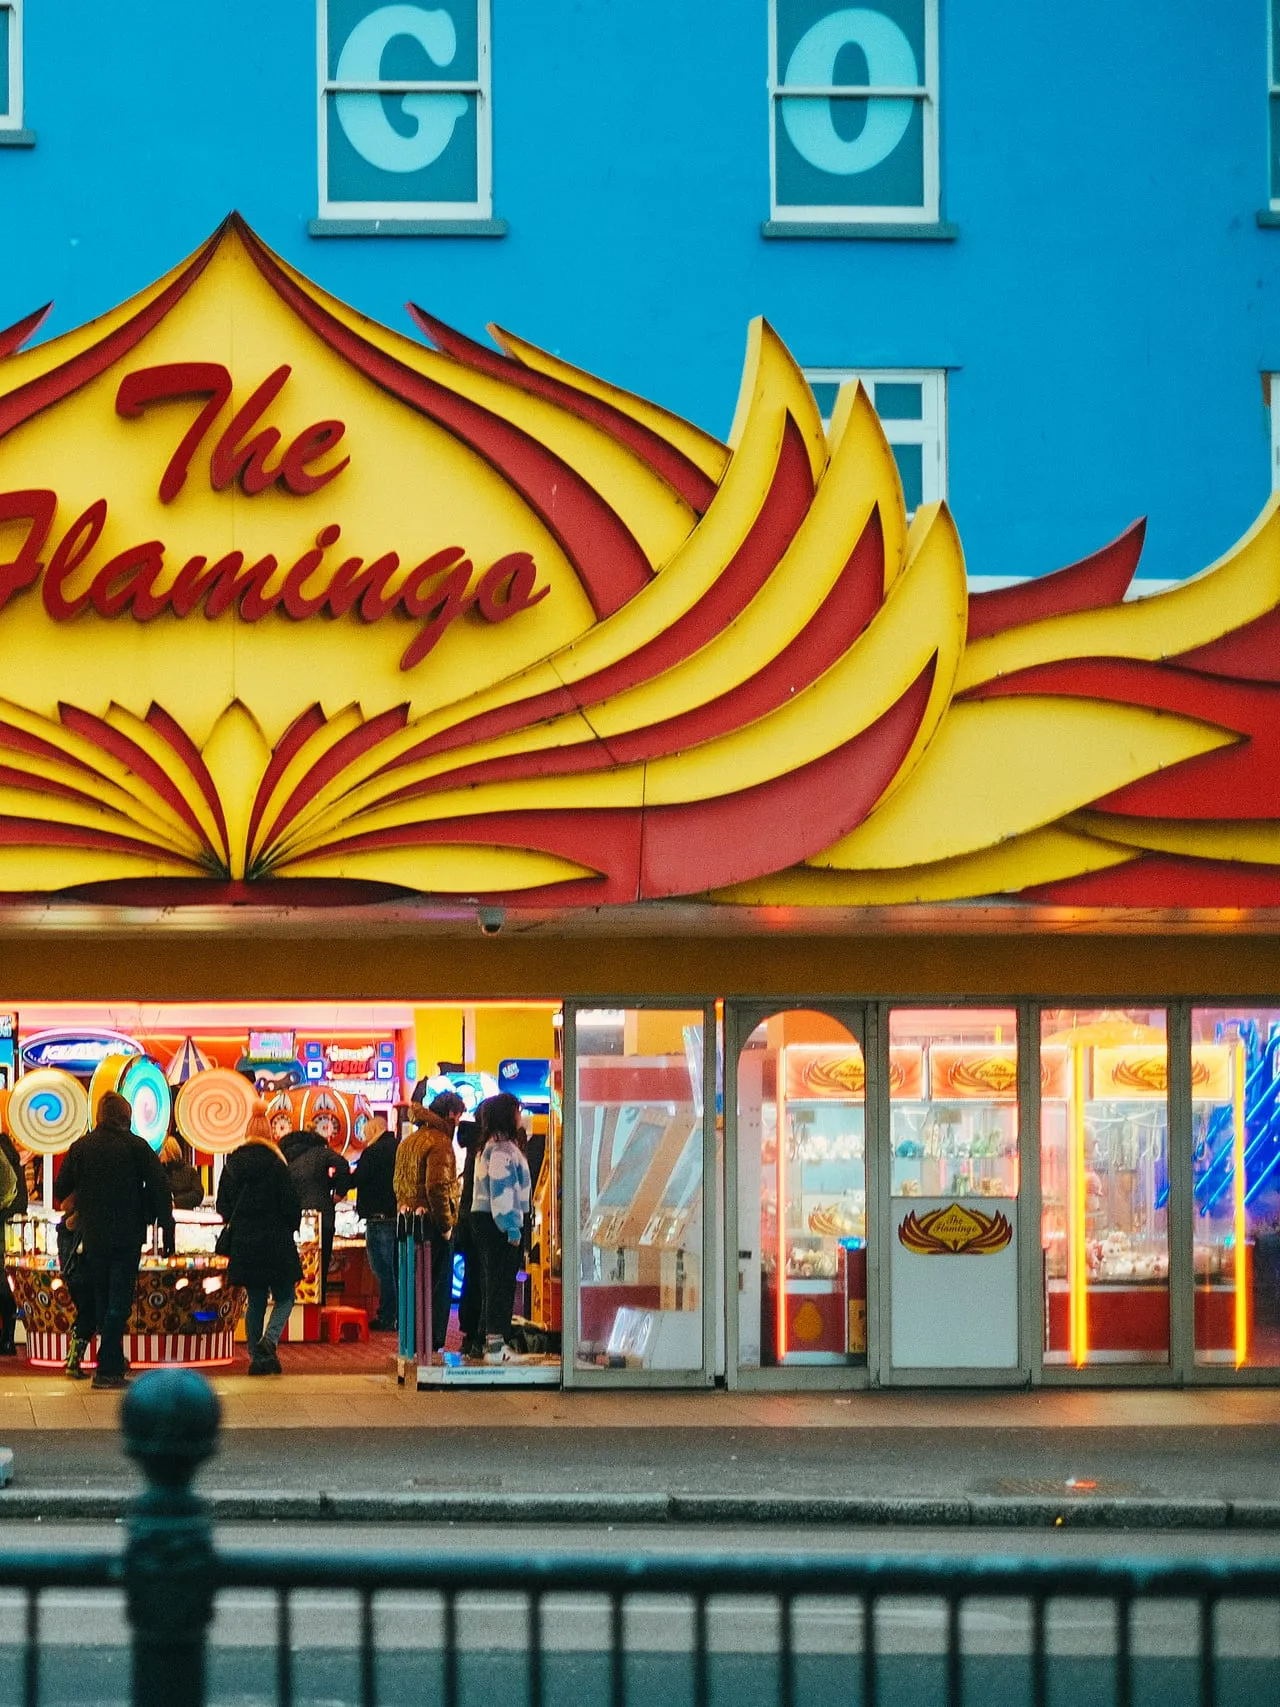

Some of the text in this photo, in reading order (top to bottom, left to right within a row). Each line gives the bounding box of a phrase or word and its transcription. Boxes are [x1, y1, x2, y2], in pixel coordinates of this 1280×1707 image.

[335, 4, 468, 173] G
[115, 362, 351, 504] The
[932, 1222, 978, 1233] Flamingo
[946, 1213, 963, 1224] The
